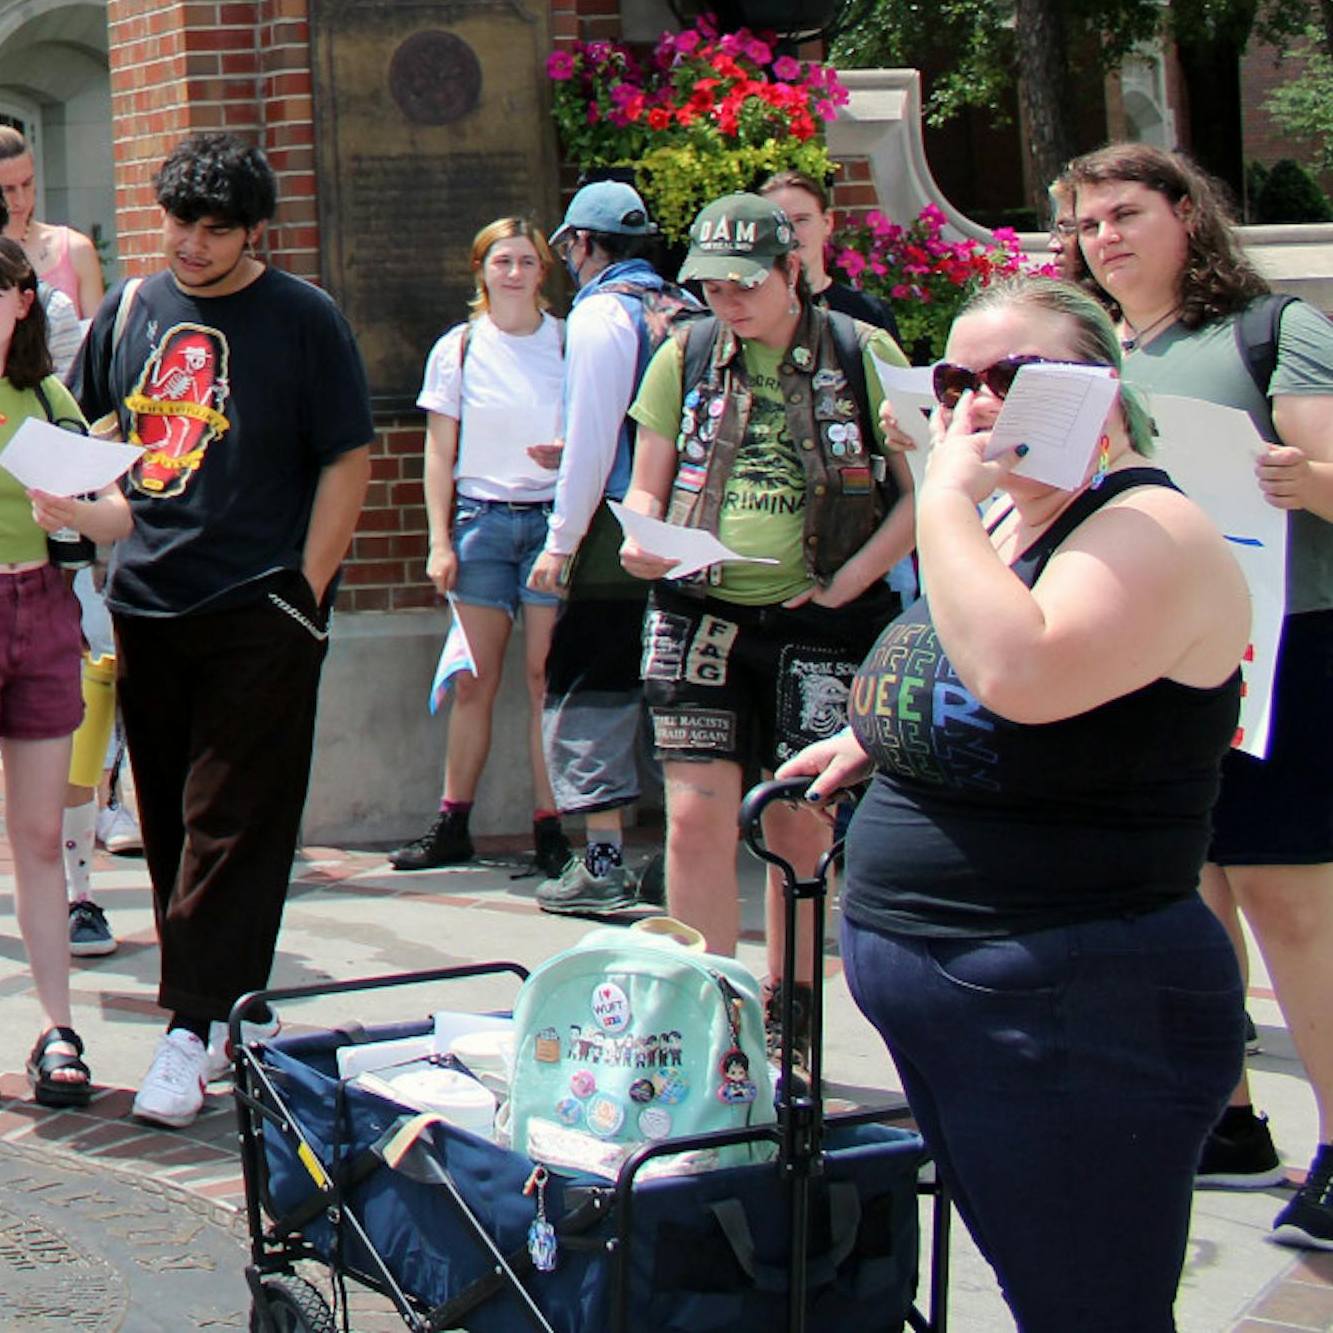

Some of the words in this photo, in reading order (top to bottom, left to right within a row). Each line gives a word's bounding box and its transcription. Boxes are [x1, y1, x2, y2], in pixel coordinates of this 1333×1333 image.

[699, 214, 756, 243] DAM
[723, 491, 805, 515] RIMINA
[679, 715, 730, 730] RACISTS
[688, 729, 729, 743] AGAIN
